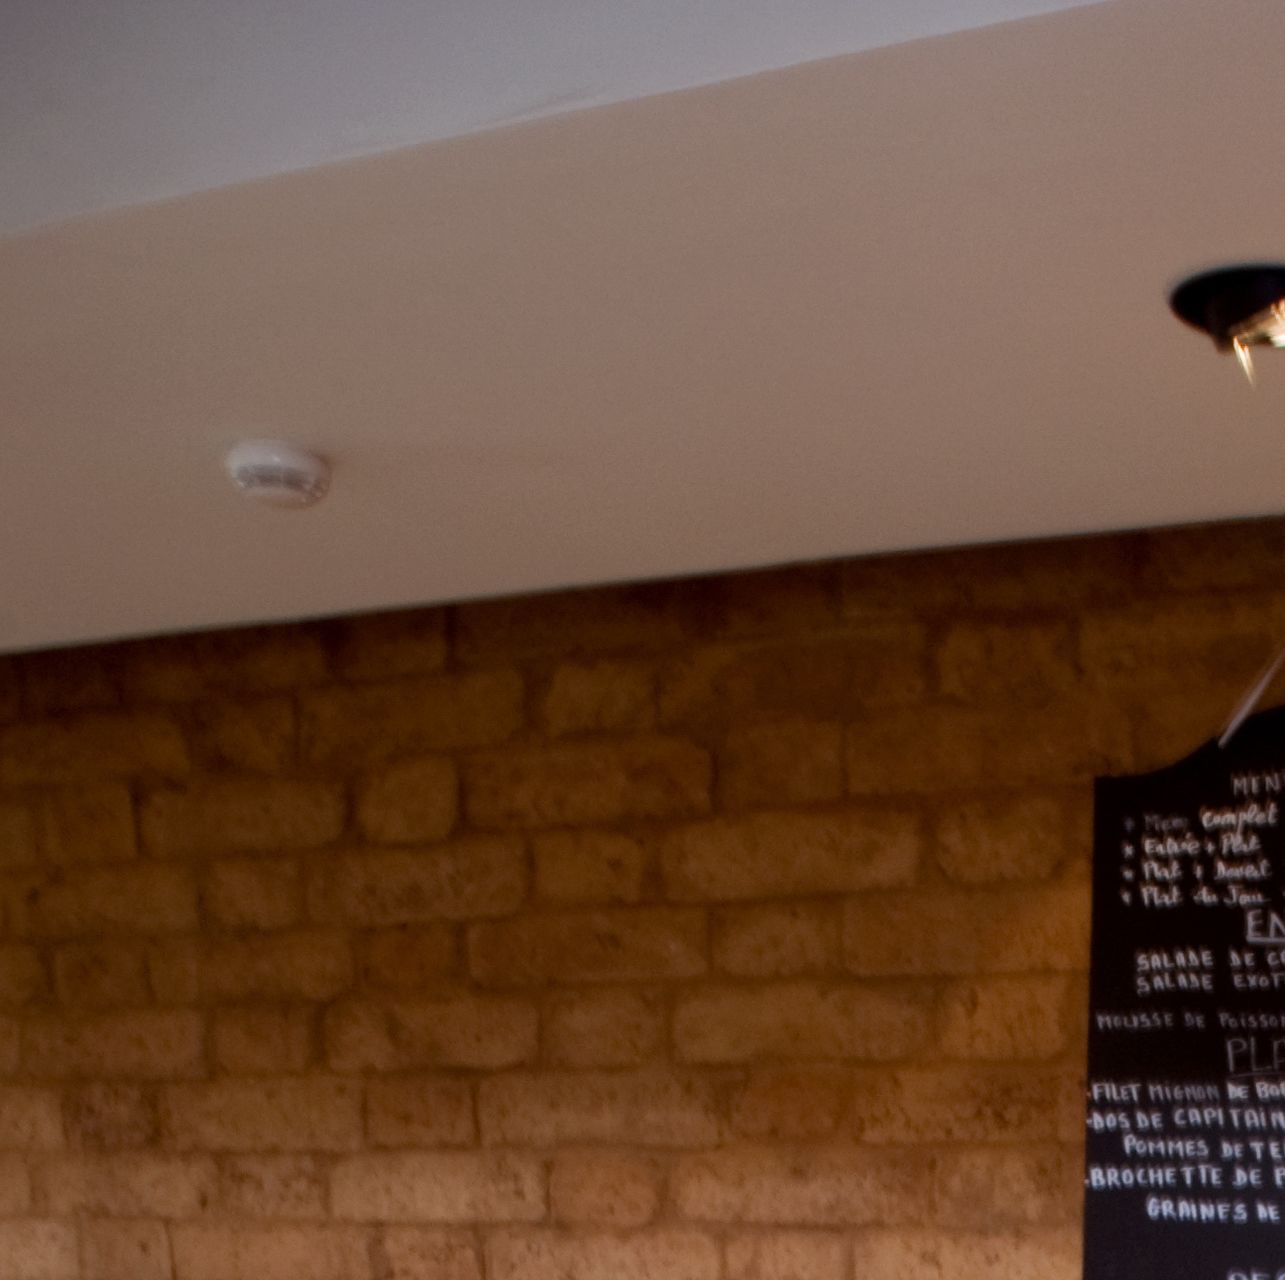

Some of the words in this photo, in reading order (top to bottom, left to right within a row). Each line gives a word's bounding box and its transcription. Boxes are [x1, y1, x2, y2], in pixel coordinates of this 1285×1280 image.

[1136, 949, 1215, 973] SALADE
[1227, 947, 1255, 969] DE
[1136, 973, 1215, 997] SALADE
[1097, 1010, 1174, 1030] MOUSSE
[1183, 1009, 1206, 1029] DE
[1091, 1080, 1141, 1101] FILET
[1226, 1080, 1249, 1099] DE
[1091, 1110, 1130, 1132] DOS
[1136, 1110, 1163, 1130] DE
[1123, 1134, 1209, 1158] POMMES
[1221, 1140, 1245, 1159] DE
[1090, 1165, 1222, 1190] BROCHETTE
[1232, 1167, 1262, 1189] DE
[1146, 1195, 1247, 1222] GRAINES
[1256, 1202, 1280, 1221] DE
